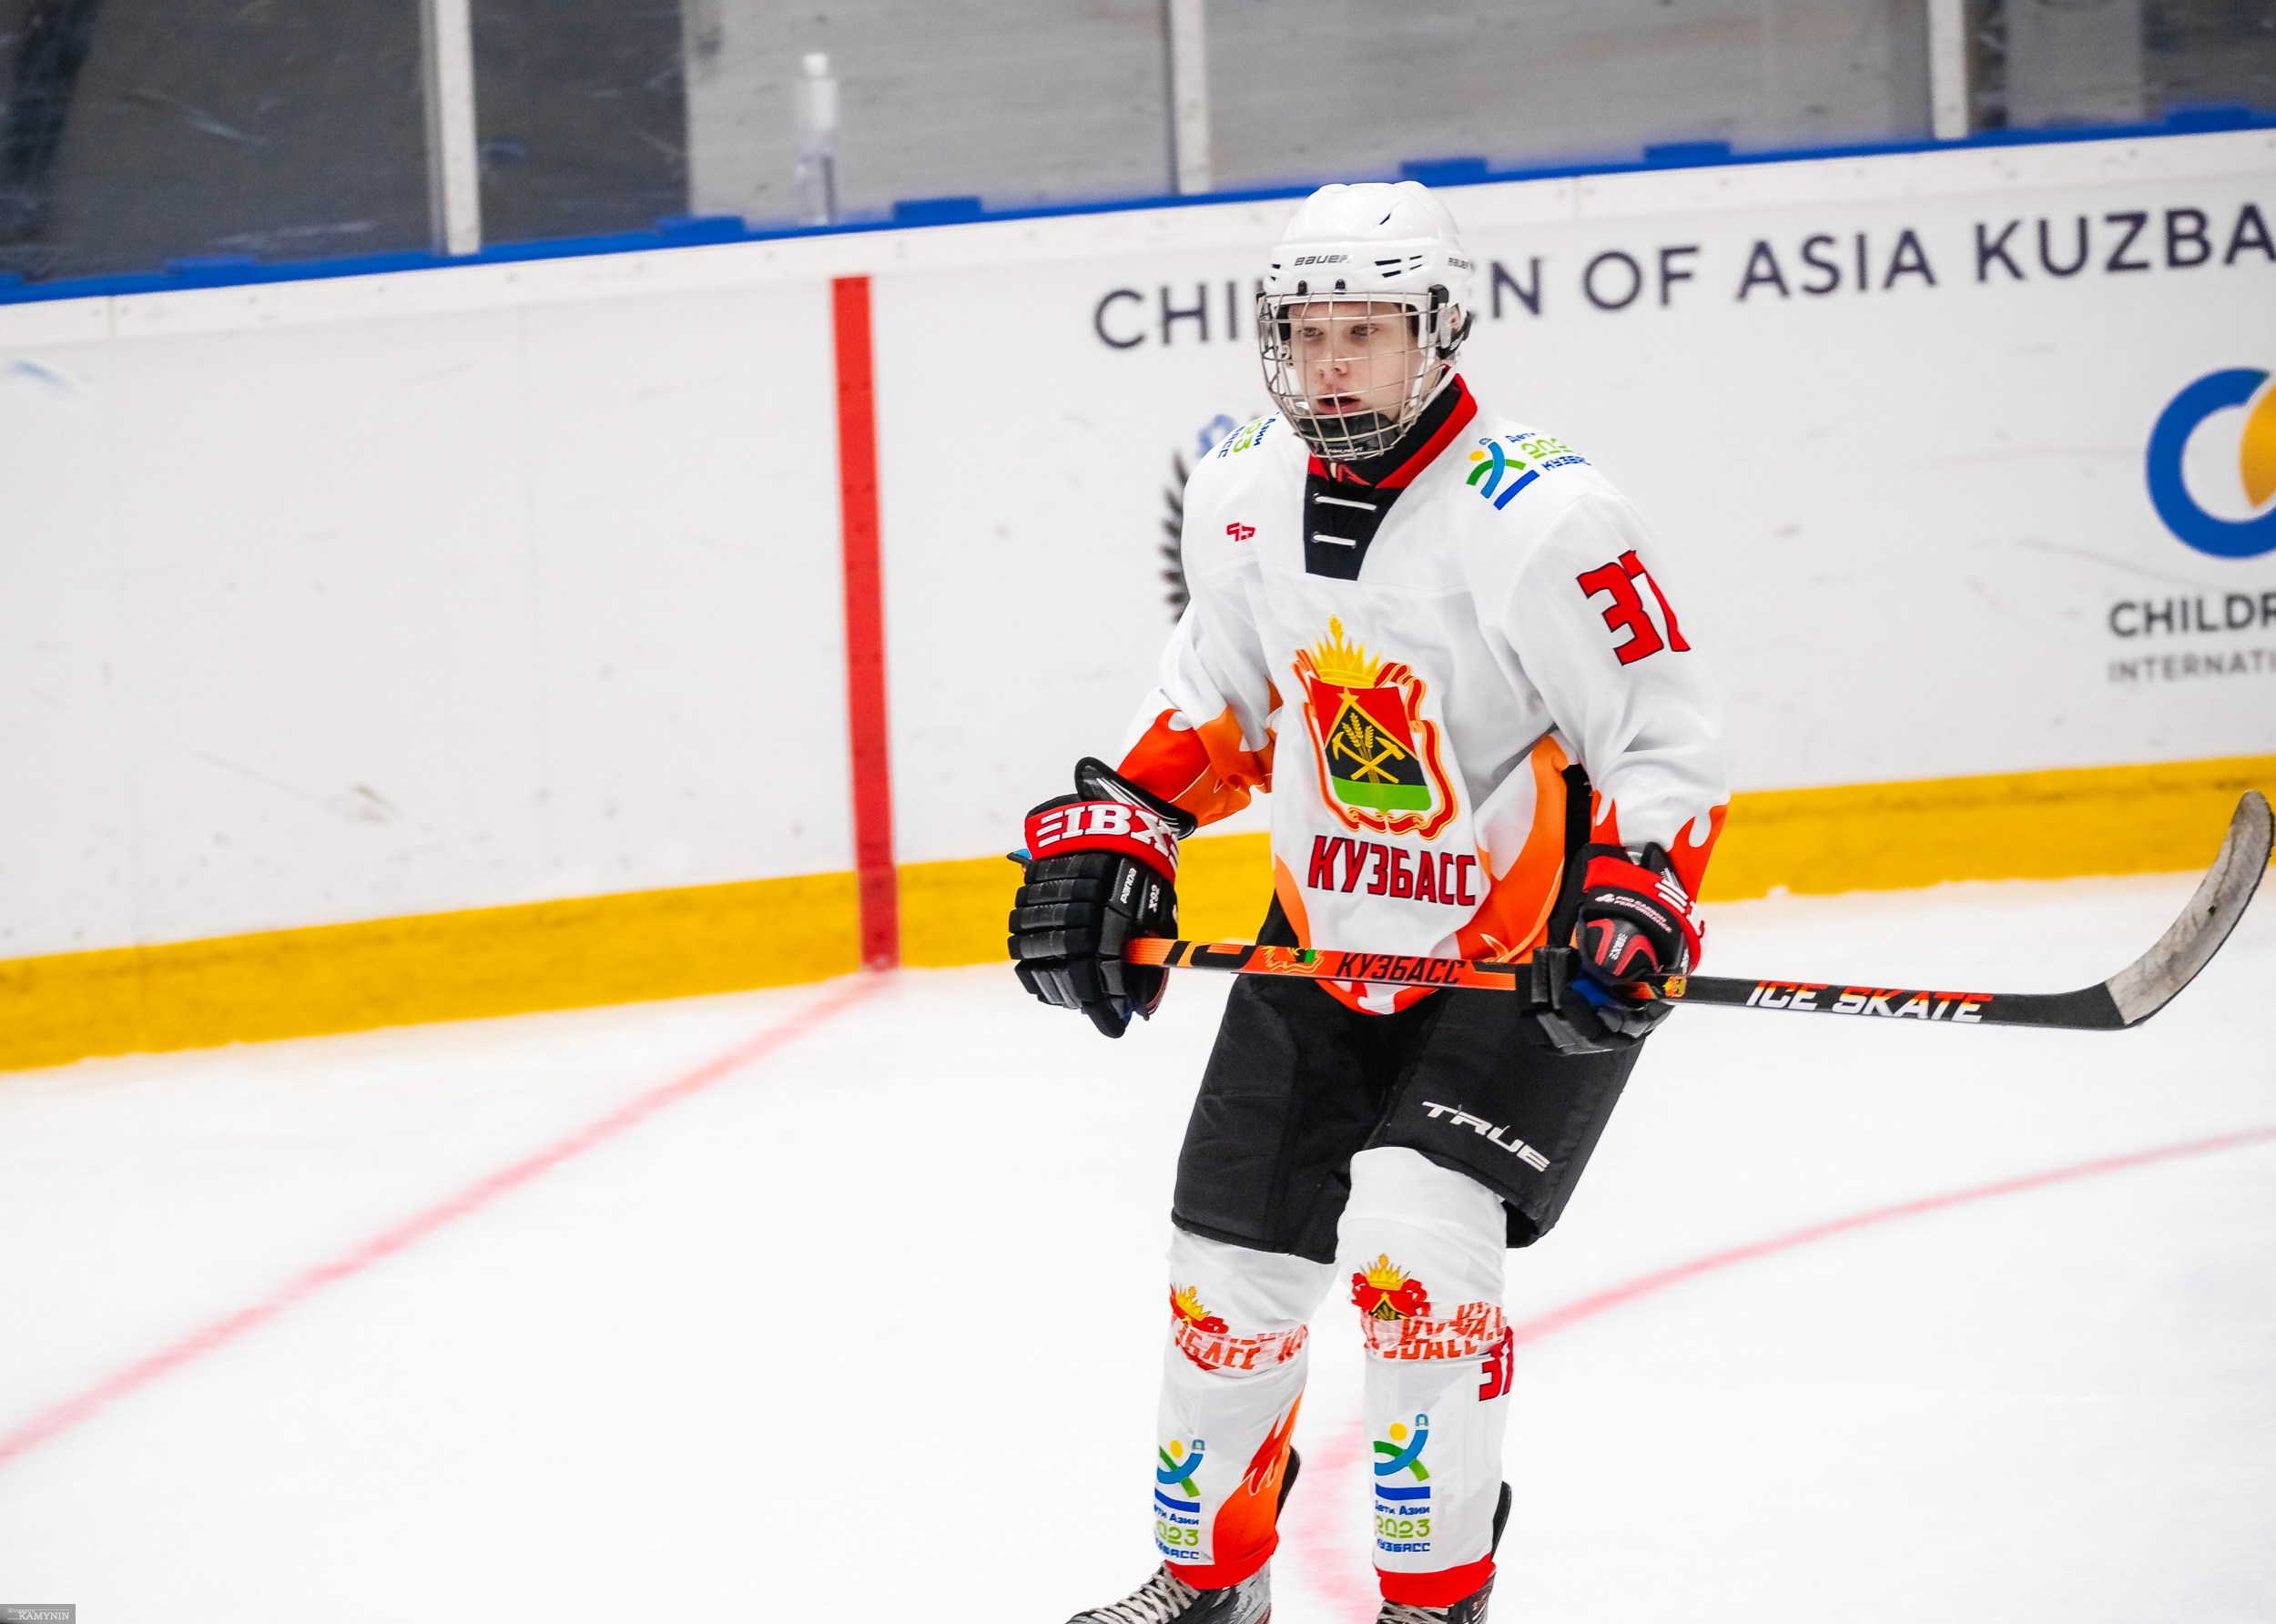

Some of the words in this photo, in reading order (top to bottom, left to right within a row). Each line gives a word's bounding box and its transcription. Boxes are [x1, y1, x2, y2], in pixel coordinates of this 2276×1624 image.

[1582, 245, 1701, 311] OF
[1735, 228, 1936, 302] ASIA
[1308, 835, 1476, 906] КУЗБАСС
[1336, 951, 1466, 985] КУЗБАСС
[1745, 979, 1828, 1011] ICE
[1832, 985, 1993, 1023] SKATE
[1422, 1101, 1550, 1172] TRUE
